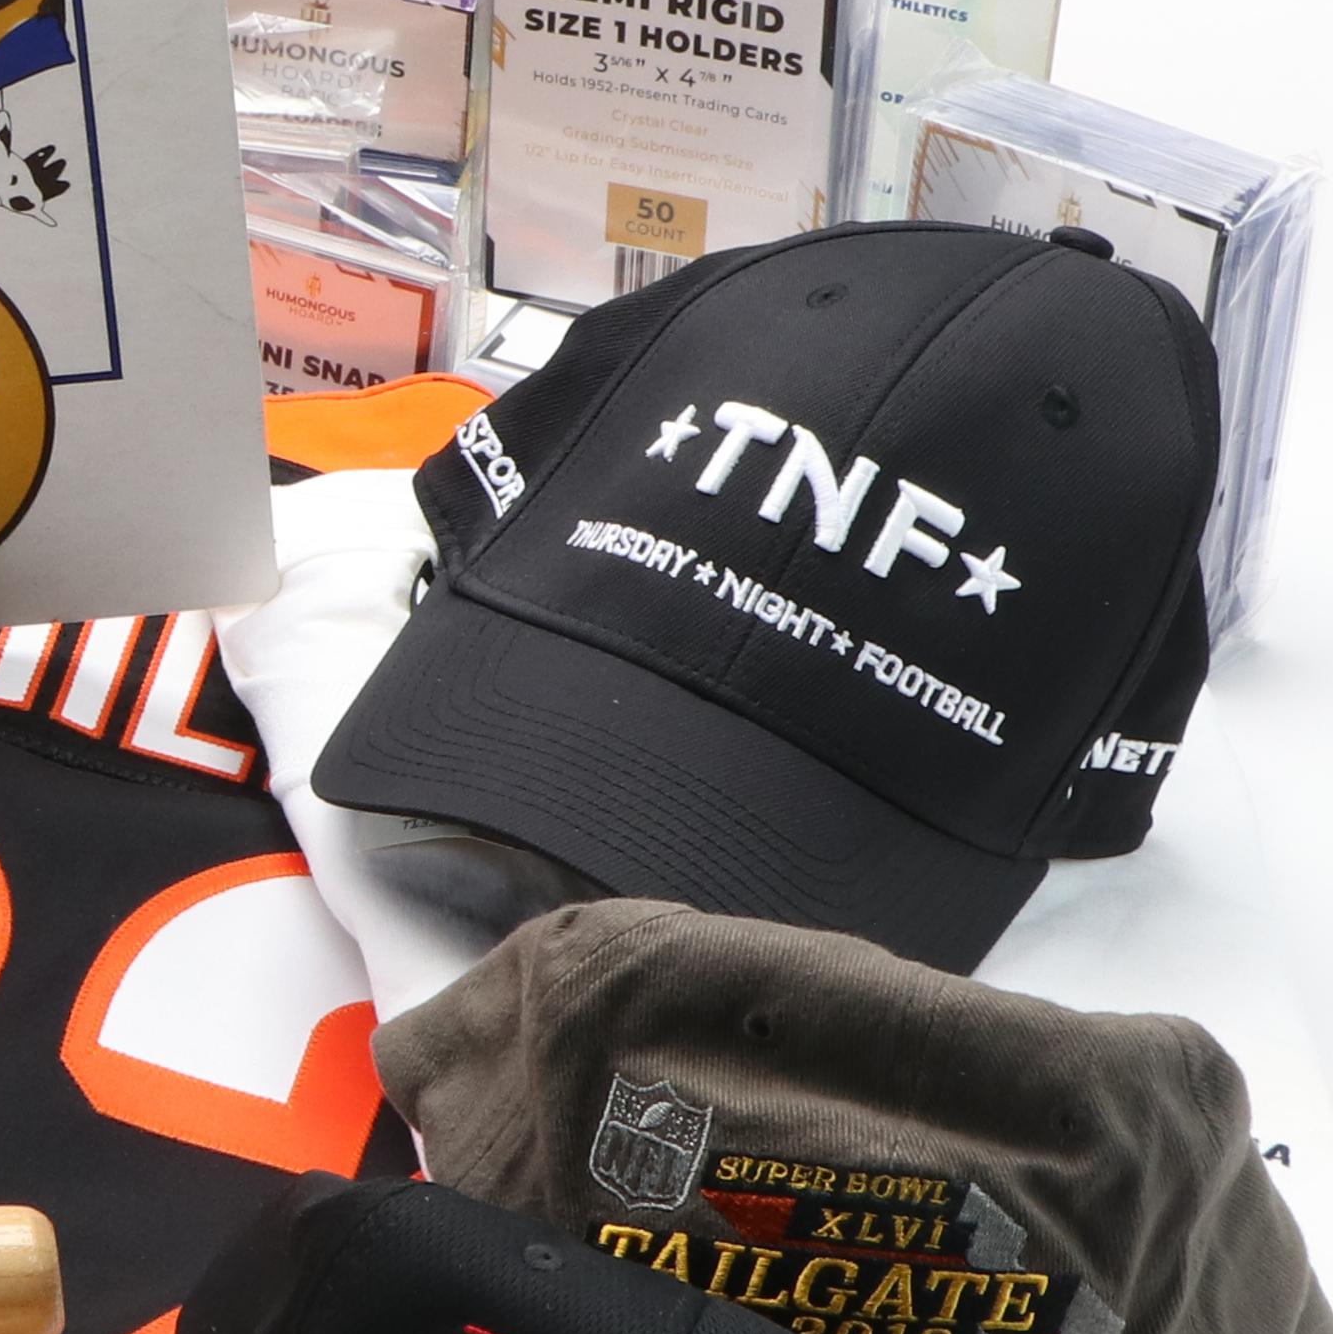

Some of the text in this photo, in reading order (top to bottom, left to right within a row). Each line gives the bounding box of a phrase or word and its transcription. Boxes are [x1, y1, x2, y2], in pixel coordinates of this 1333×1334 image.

[524, 8, 803, 77] SIZE HOLDERS
[533, 70, 788, 126] Holds 1952-Present Trading Cards
[625, 220, 686, 244] COUNT
[636, 197, 675, 224] 50
[266, 287, 355, 322] HUMONGOUS
[695, 401, 964, 579] TNF
[567, 518, 1004, 746] THURSDAY NIGHT FOOTBALL
[715, 1155, 953, 1206] SUPER BOWL
[812, 1207, 950, 1251] XLVI
[599, 1222, 1049, 1333] TAILGATE
